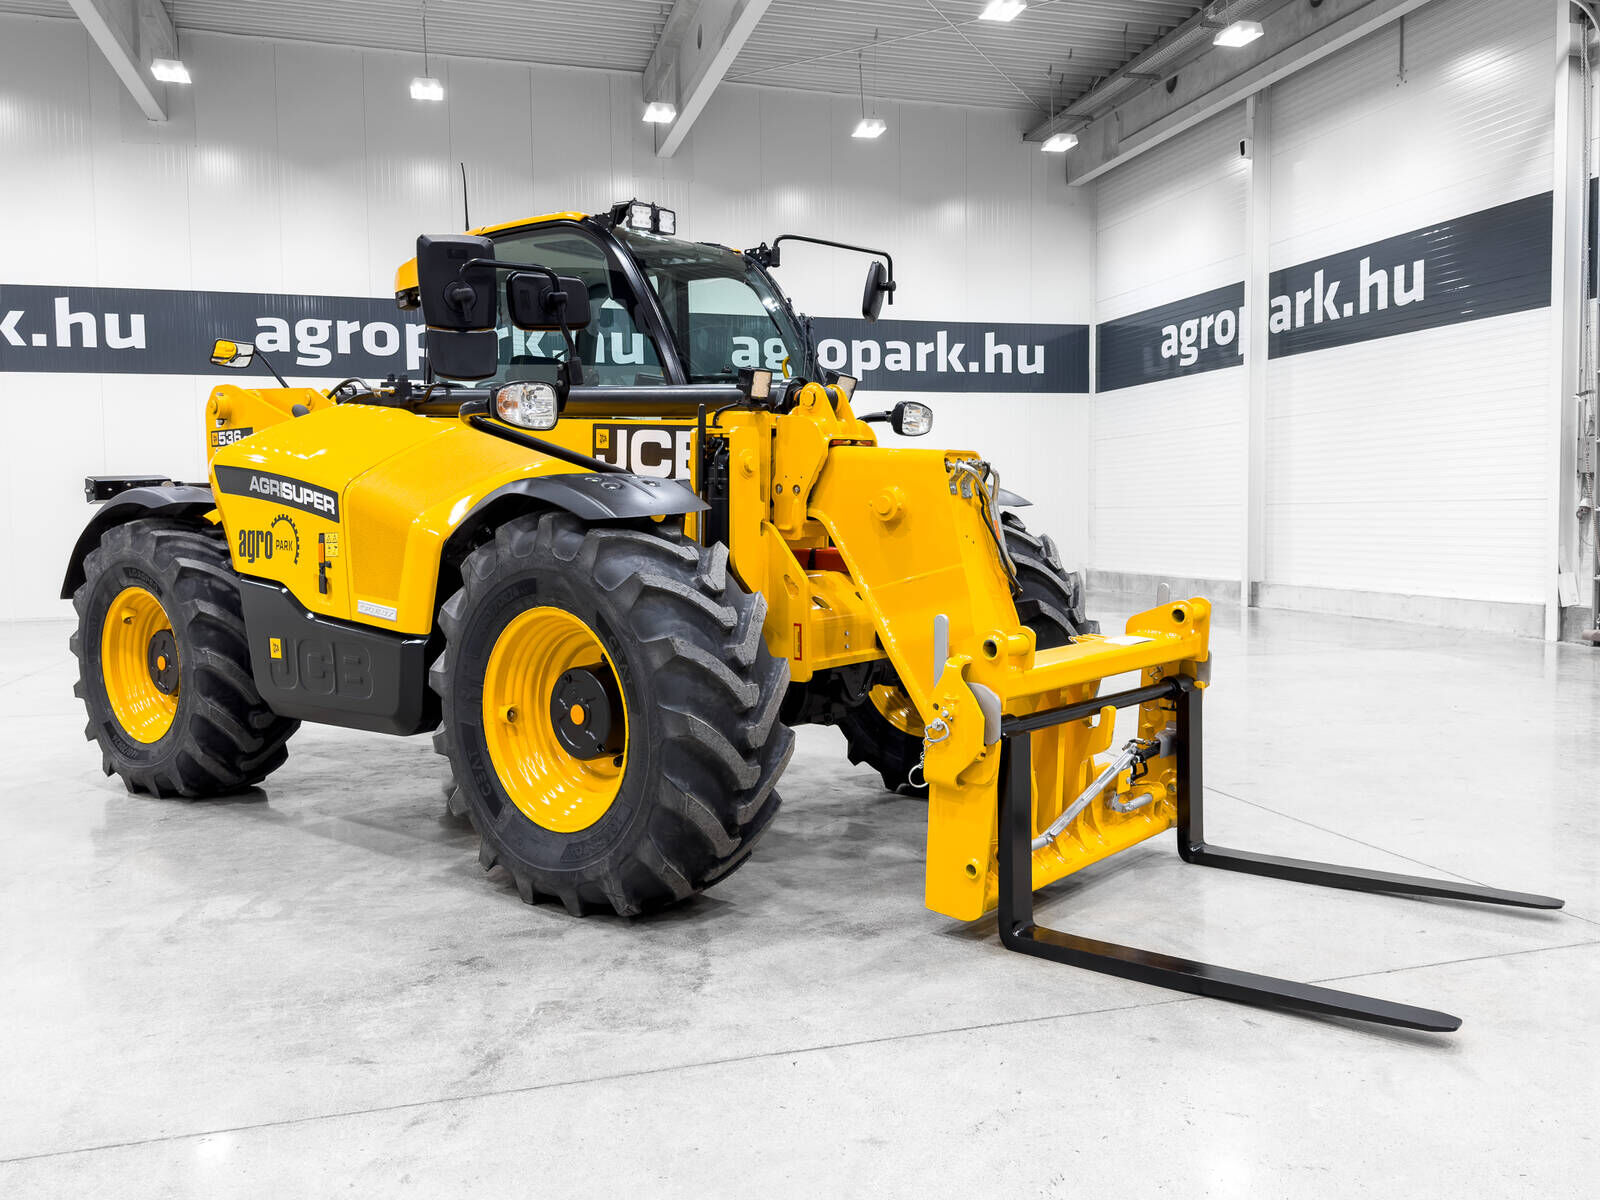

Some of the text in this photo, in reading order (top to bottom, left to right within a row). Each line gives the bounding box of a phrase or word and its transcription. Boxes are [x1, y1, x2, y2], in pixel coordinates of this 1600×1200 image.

[1161, 256, 1425, 367] agroark.hu
[731, 330, 1046, 383] agopark.hu
[239, 529, 293, 564] agro PARK
[269, 637, 375, 700] JCB
